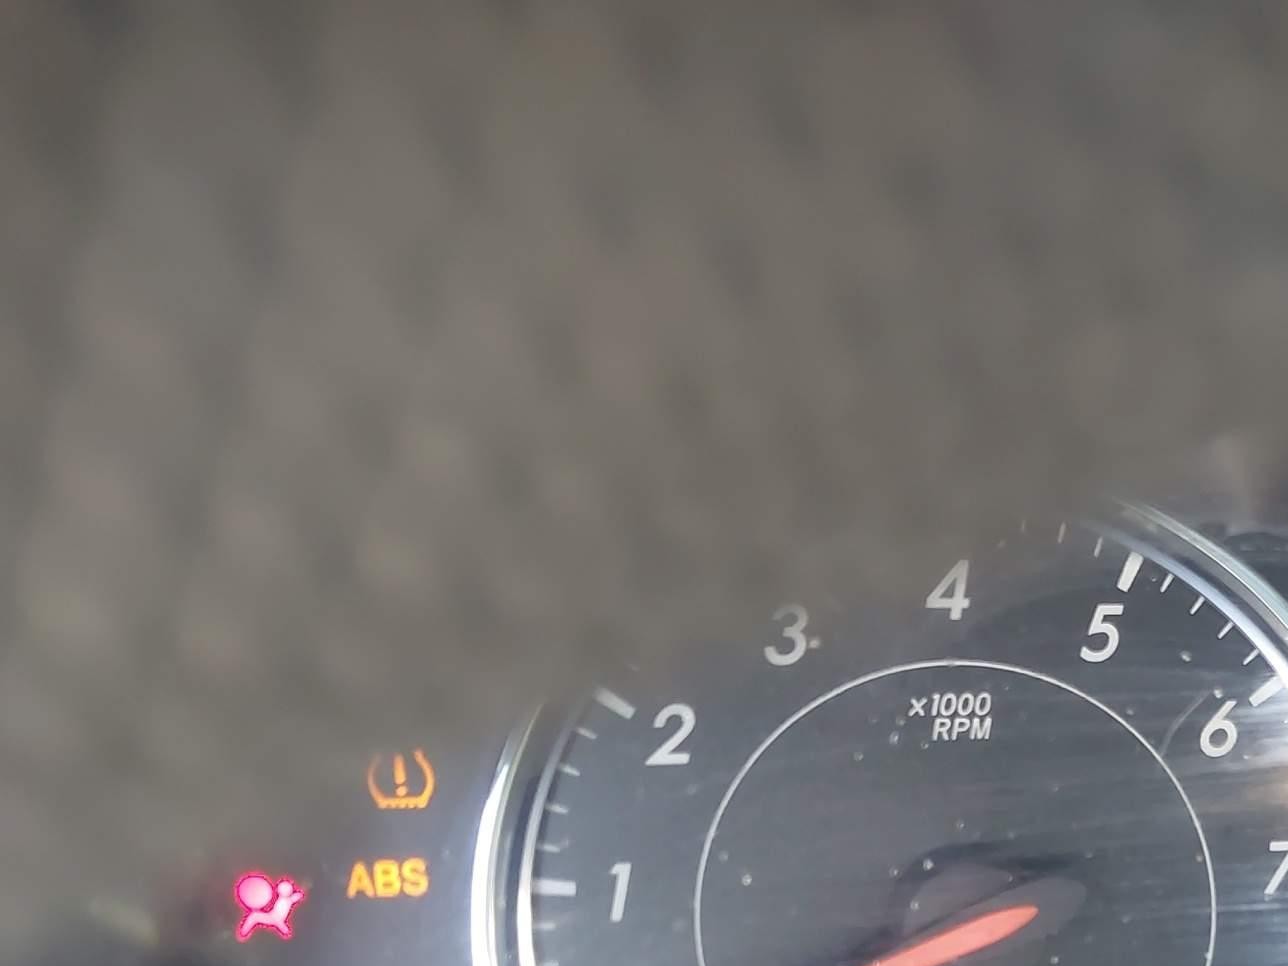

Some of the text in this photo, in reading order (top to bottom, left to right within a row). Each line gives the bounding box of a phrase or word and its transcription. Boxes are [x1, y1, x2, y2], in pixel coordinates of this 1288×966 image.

[925, 559, 971, 621] 4
[764, 605, 809, 665] 3
[1080, 602, 1124, 663] 5
[645, 703, 697, 766] 2
[931, 718, 992, 741] RPM
[1199, 700, 1238, 757] 6
[347, 858, 429, 898] ABS
[609, 862, 632, 922] 1
